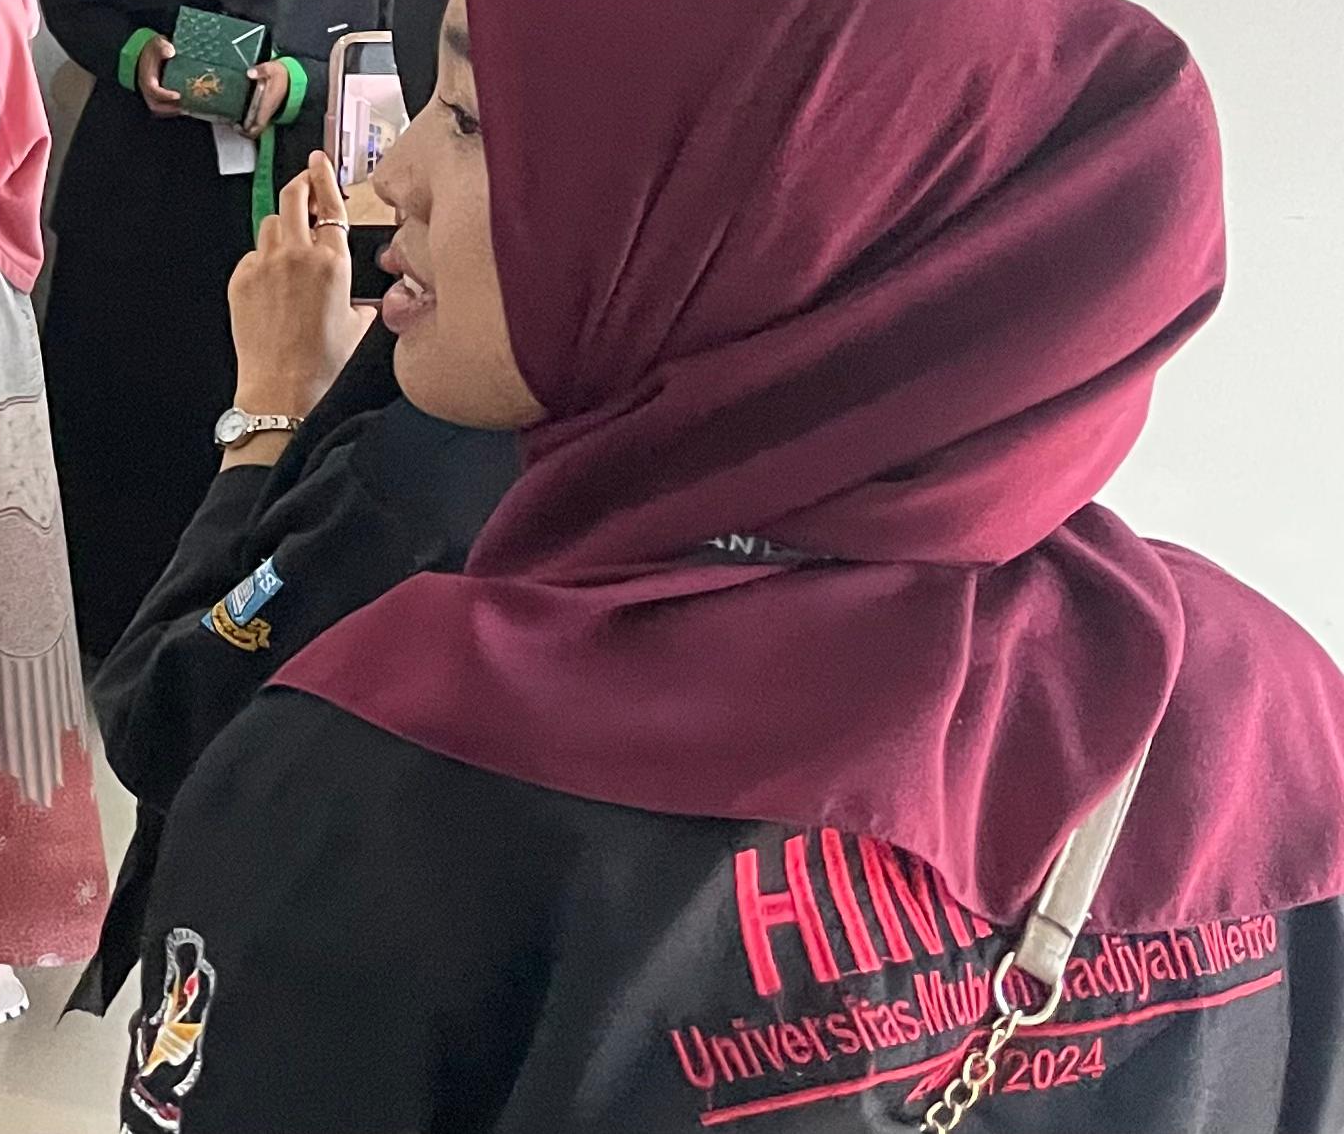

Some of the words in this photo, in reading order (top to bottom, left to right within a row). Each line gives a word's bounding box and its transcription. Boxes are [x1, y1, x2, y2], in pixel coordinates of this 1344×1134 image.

[735, 827, 994, 997] HIM
[671, 996, 920, 1088] Universitas
[1198, 914, 1277, 975] Metro
[1002, 1037, 1107, 1093] 2024
